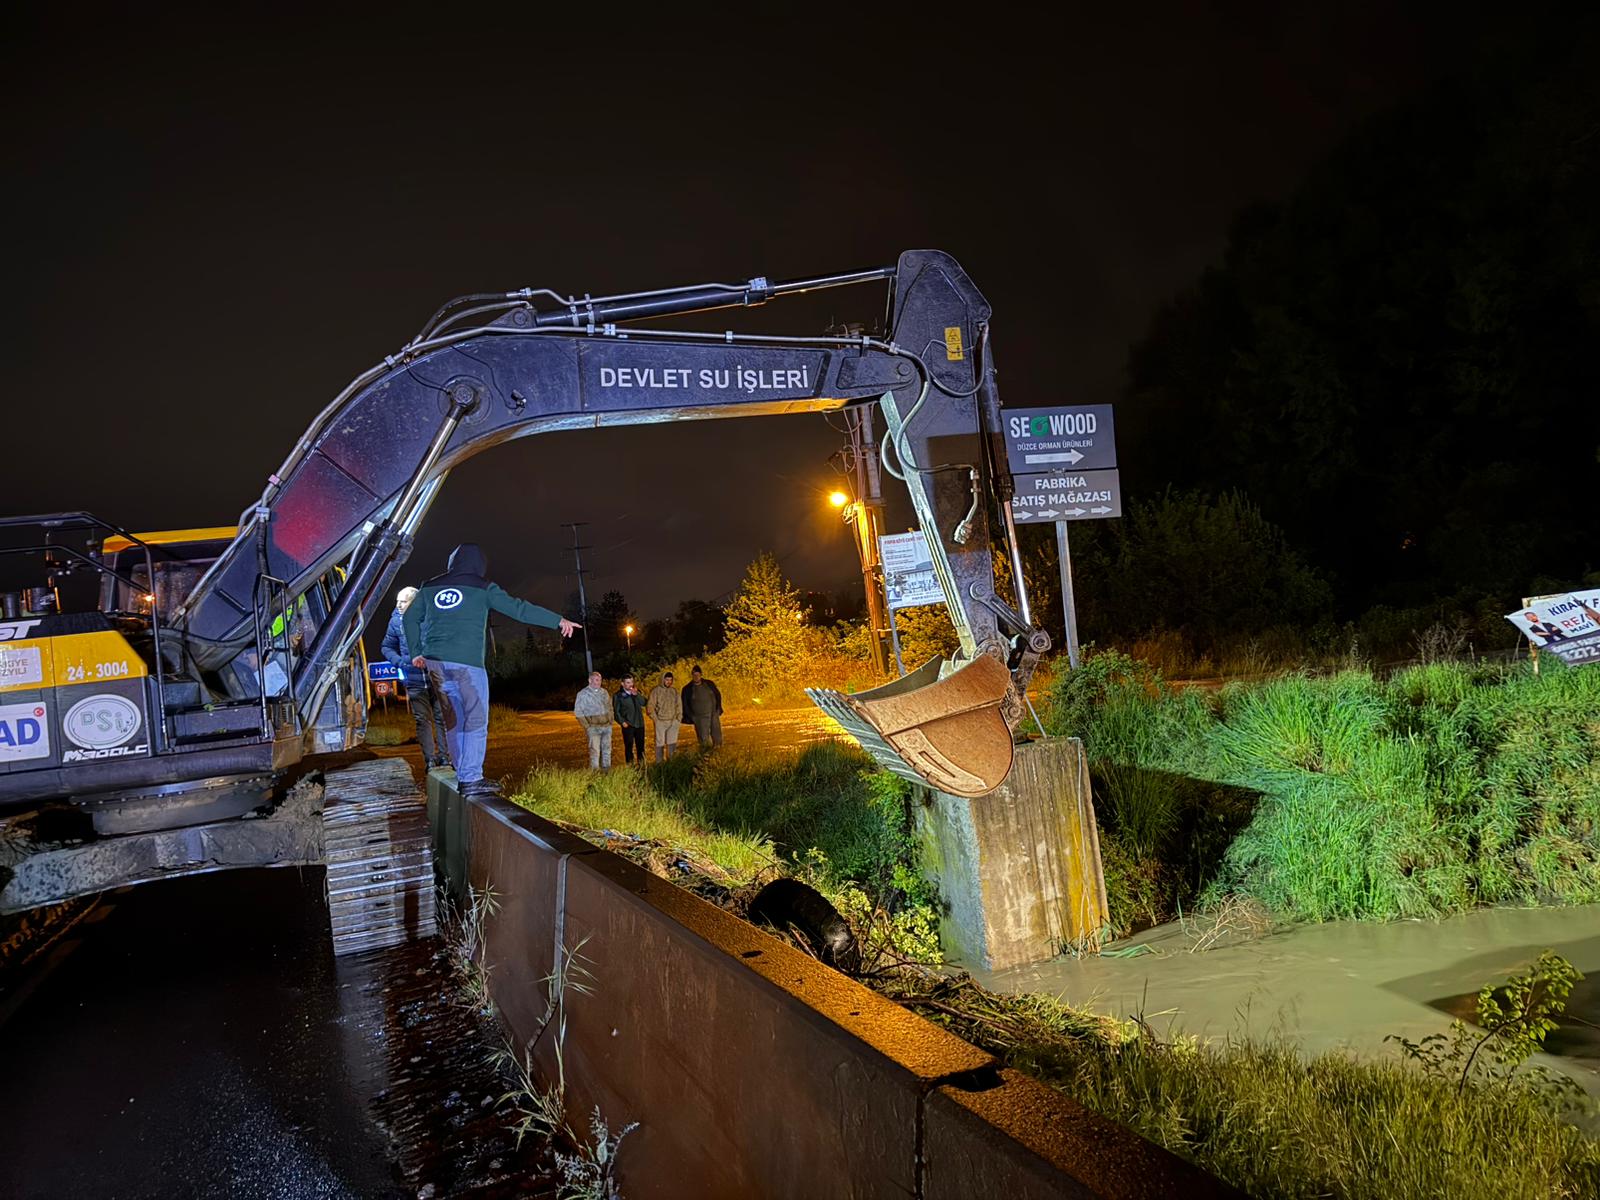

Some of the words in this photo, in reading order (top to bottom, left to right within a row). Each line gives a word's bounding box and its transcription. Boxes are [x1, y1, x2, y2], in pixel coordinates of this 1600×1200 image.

[600, 367, 692, 388] DEVLET
[699, 369, 730, 389] SU
[736, 365, 809, 393] İŞLERİ
[1017, 442, 1037, 451] DÜZCE
[1038, 442, 1061, 450] ORMAN
[1062, 438, 1093, 448] ÜRÜNLERİ
[1012, 494, 1046, 507] SATIŞ
[1048, 490, 1112, 505] MAĞAZASI
[67, 666, 84, 681] 24
[95, 661, 128, 678] 3004
